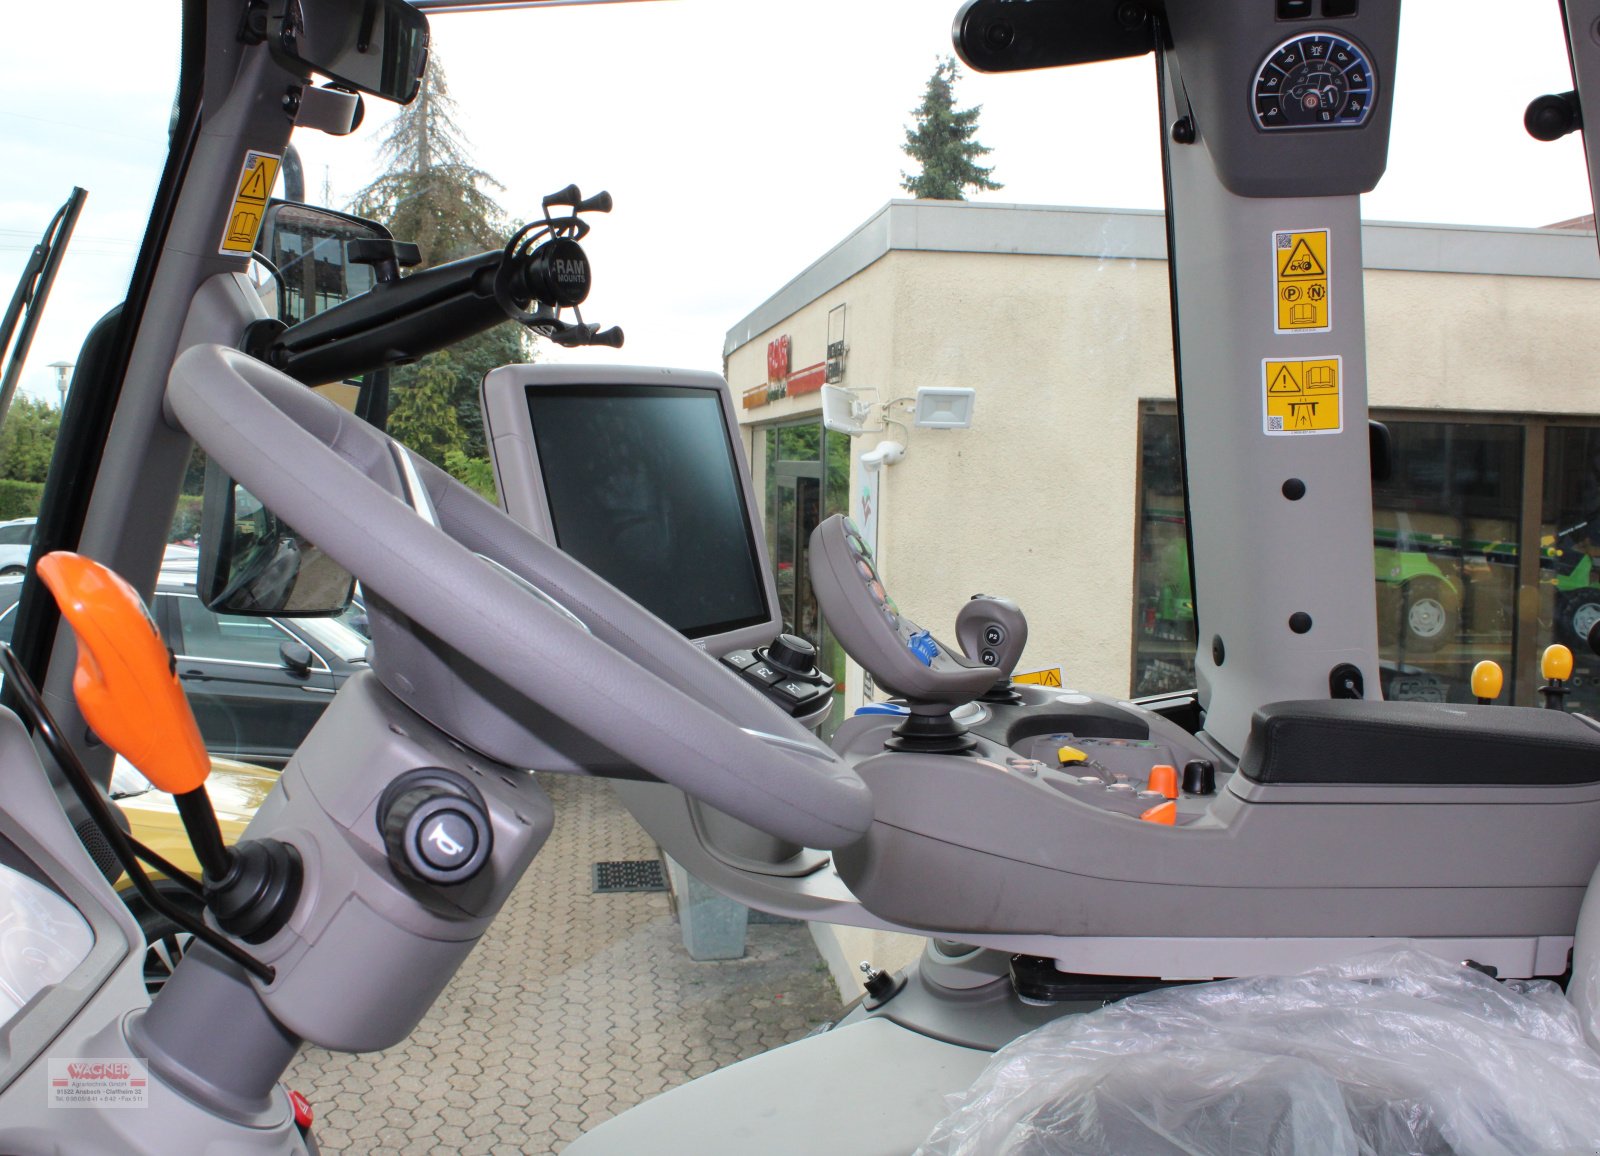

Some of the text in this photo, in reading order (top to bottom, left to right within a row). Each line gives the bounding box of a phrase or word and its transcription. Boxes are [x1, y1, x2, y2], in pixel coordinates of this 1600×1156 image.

[556, 259, 585, 275] RAM
[558, 274, 586, 283] MOUNTS
[1287, 287, 1321, 300] P N
[757, 667, 774, 678] F2
